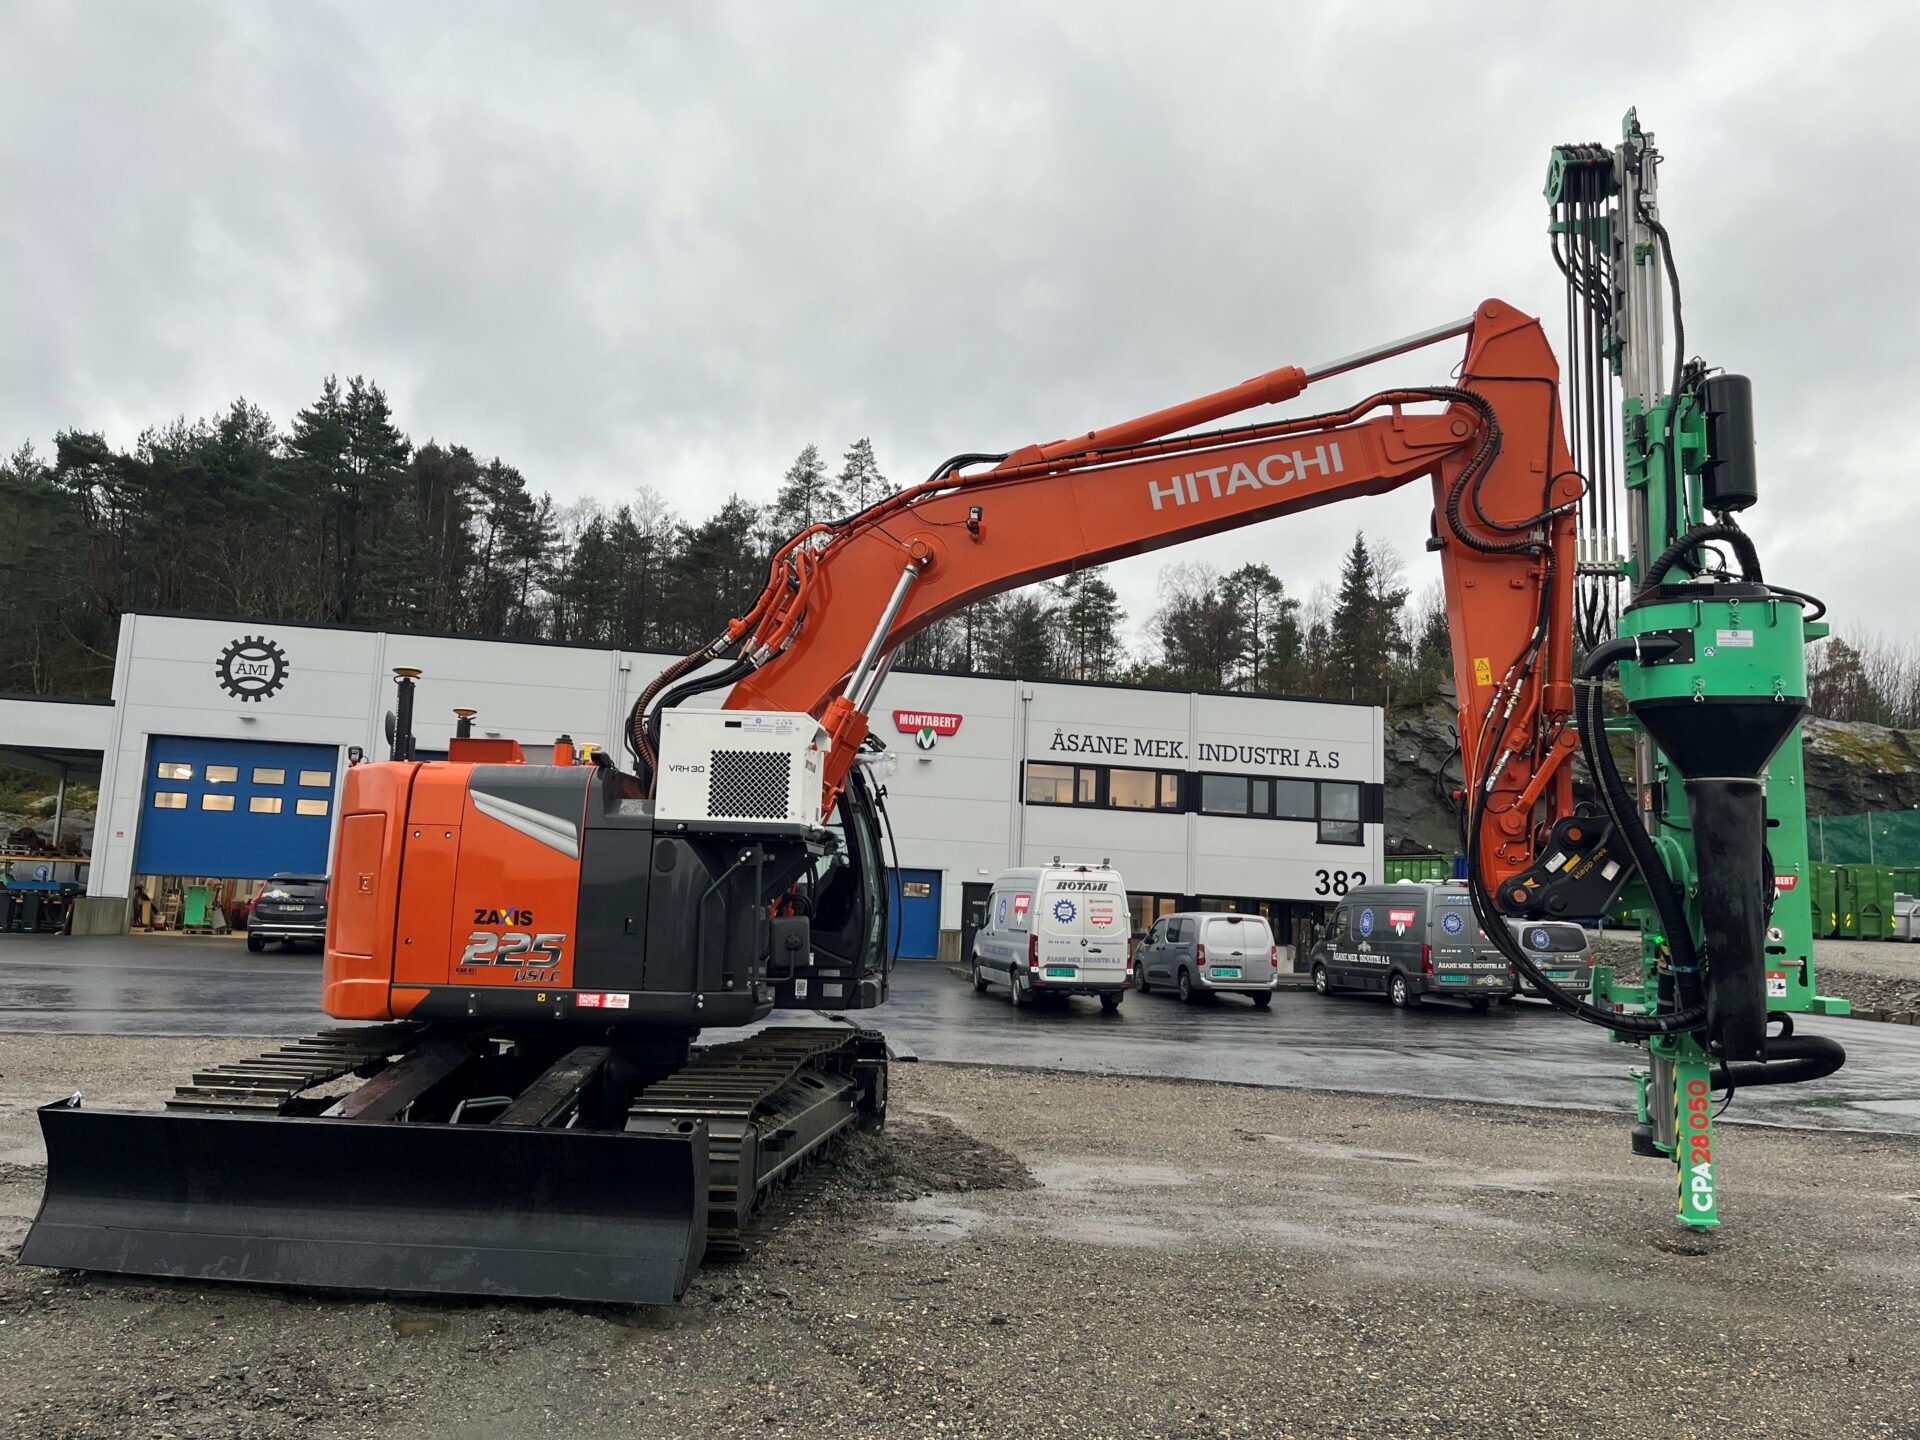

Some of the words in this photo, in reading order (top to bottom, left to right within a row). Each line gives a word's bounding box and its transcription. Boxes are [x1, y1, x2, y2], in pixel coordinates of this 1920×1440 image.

[1148, 442, 1344, 511] HITACHI
[899, 713, 957, 728] MONTABERT
[1050, 728, 1128, 755] ÅSANE
[1133, 738, 1188, 759] MEK.
[1198, 743, 1300, 766] INDUSTRI
[1305, 750, 1340, 769] A.S
[668, 764, 690, 773] VRH
[690, 765, 705, 773] 30
[1573, 861, 1594, 880] klepp
[1314, 869, 1366, 896] 382
[473, 906, 534, 926] ZAXIS
[460, 931, 568, 968] 225
[513, 969, 562, 983] USLC
